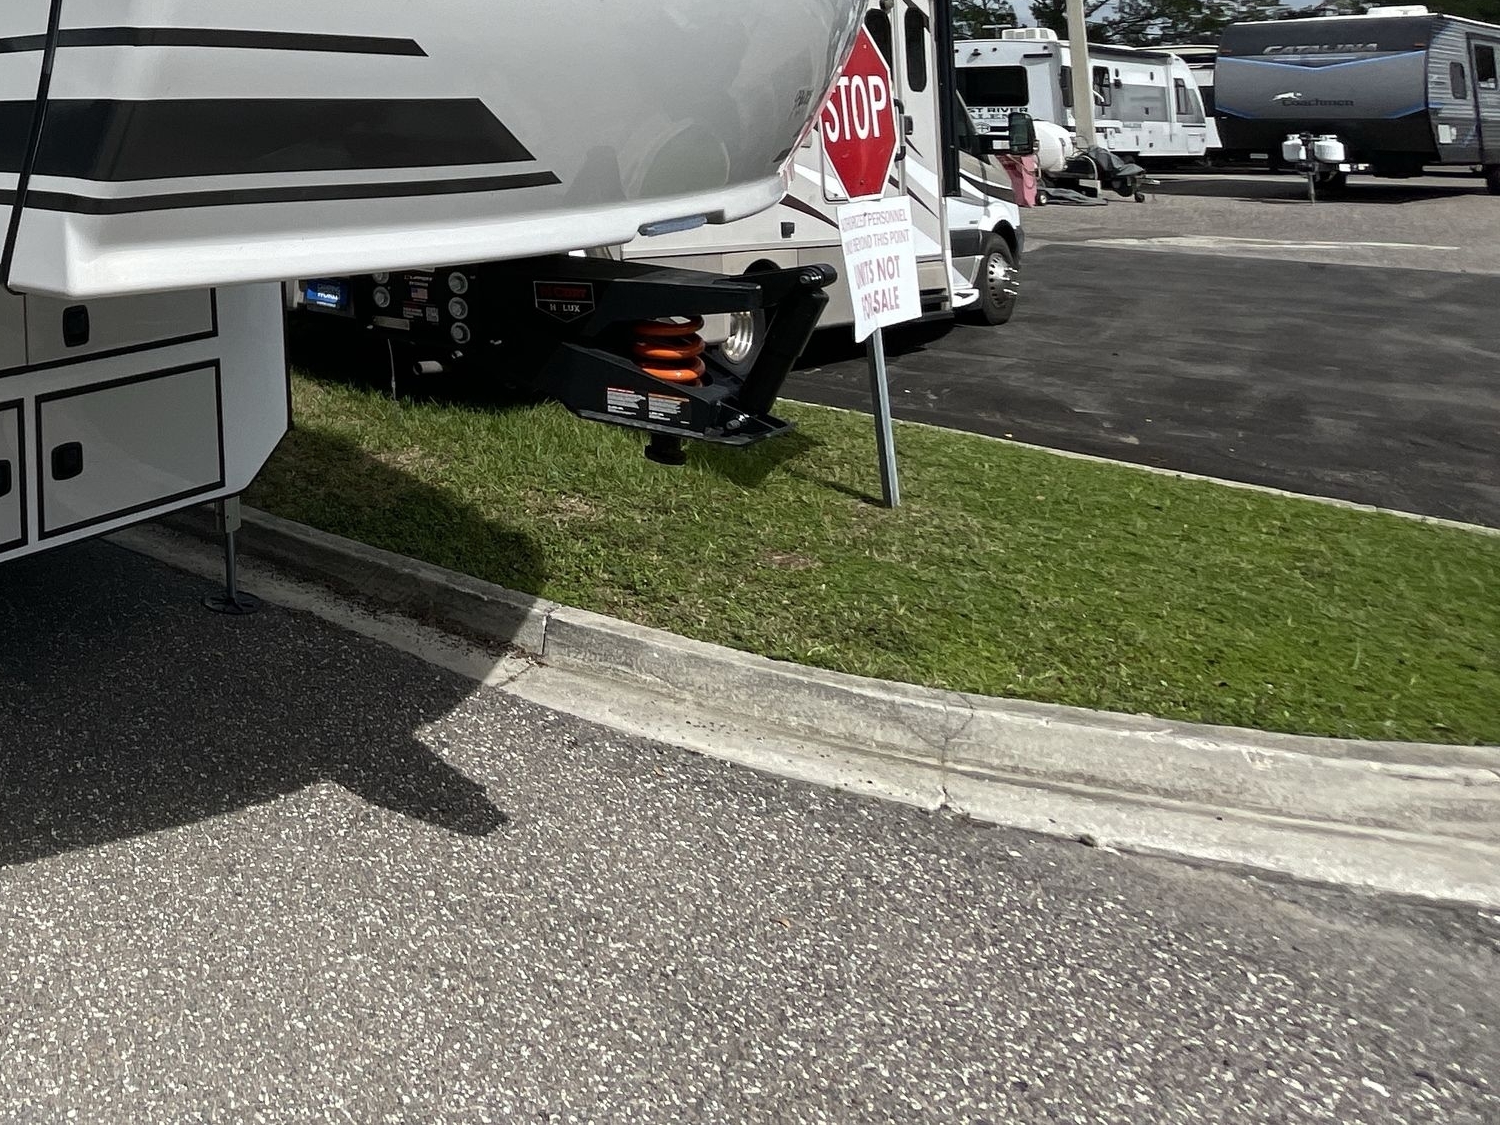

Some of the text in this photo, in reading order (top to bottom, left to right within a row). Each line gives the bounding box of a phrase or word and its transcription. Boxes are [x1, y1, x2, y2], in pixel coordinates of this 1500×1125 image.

[1263, 44, 1378, 54] CATALINA
[825, 75, 887, 143] STOP
[1282, 98, 1354, 106] Coachmen
[867, 208, 908, 226] PERSONNEL
[873, 232, 889, 247] THIS
[889, 229, 910, 244] POINT
[876, 255, 901, 282] NOT
[549, 303, 581, 313] HLUX
[873, 286, 901, 314] SALE
